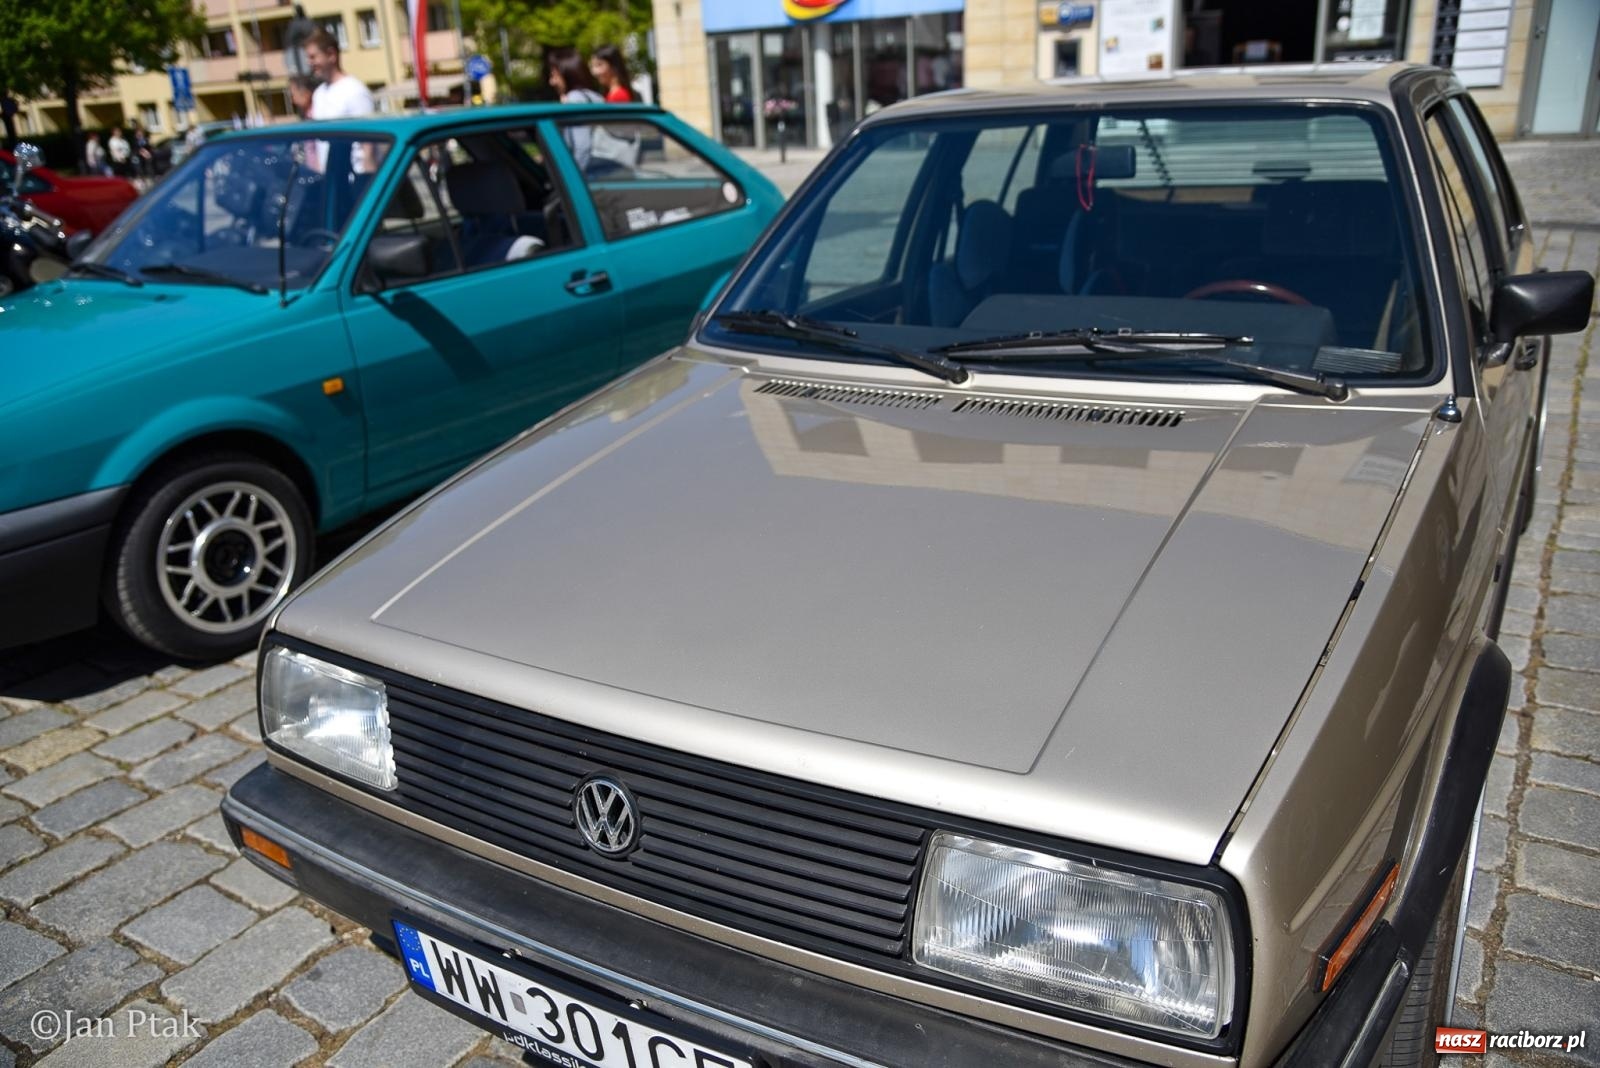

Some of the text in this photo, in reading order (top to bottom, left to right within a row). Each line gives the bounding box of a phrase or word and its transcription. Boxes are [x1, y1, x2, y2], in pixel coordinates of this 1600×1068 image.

[579, 781, 631, 850] VW
[409, 957, 430, 979] PL
[429, 939, 508, 1022] WW
